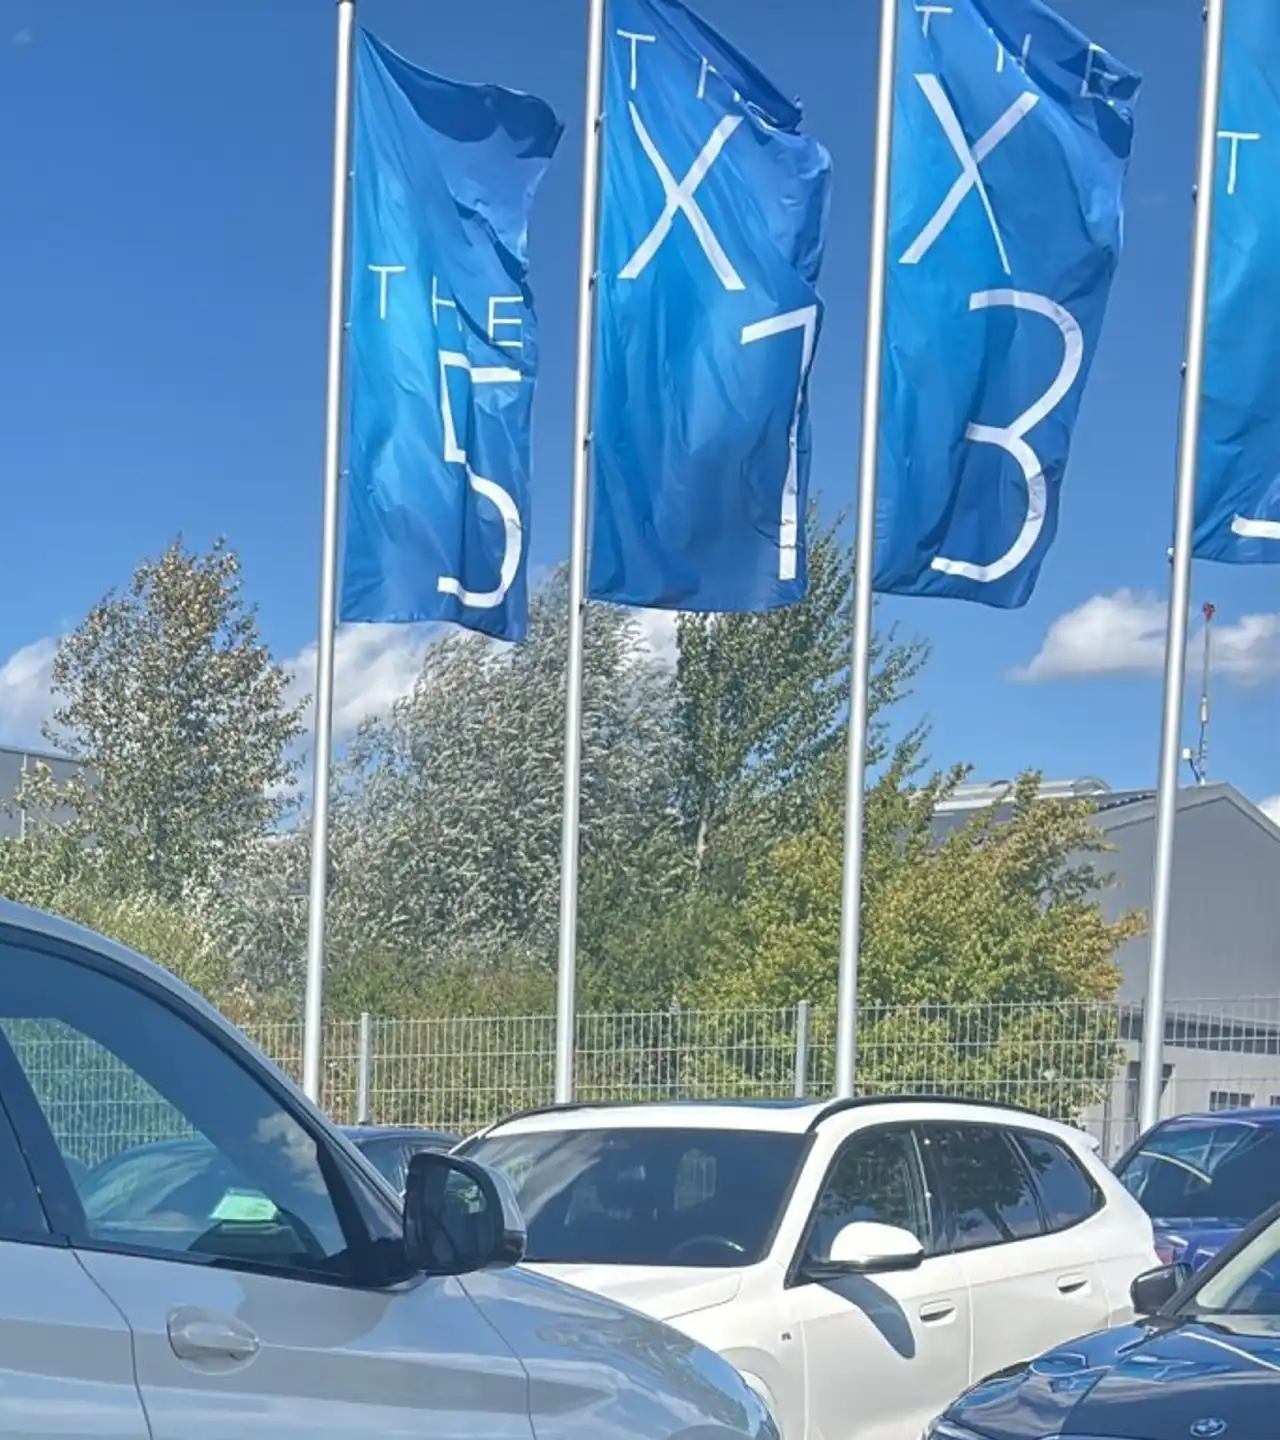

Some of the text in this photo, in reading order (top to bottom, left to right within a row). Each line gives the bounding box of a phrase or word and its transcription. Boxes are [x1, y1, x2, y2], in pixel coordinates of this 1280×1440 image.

[618, 100, 745, 290] X
[898, 73, 1040, 276] X
[367, 263, 524, 349] THE
[437, 350, 523, 609] 5
[930, 288, 1084, 583] 3
